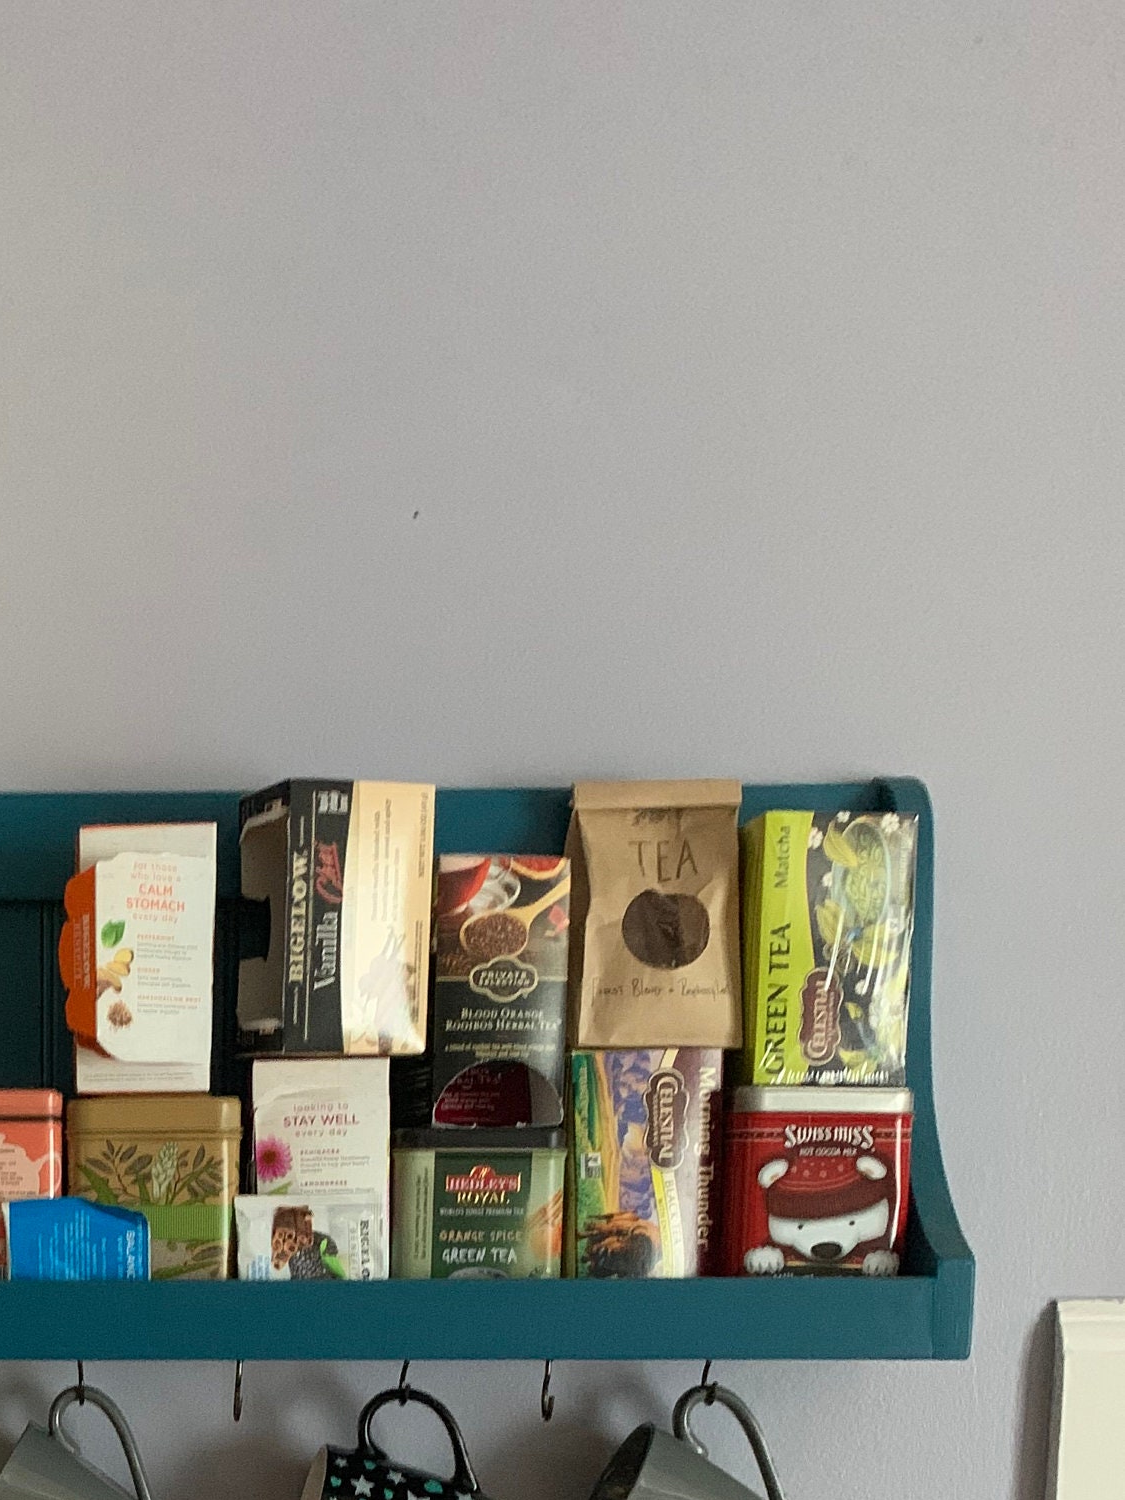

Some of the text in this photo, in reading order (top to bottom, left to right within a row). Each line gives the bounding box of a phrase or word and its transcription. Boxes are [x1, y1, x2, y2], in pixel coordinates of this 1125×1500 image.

[628, 839, 698, 883] TEA
[774, 825, 791, 888] Matcha
[153, 872, 173, 882] love
[314, 838, 343, 904] Chai
[138, 883, 173, 896] CALM
[126, 897, 185, 912] STOMACH
[132, 913, 179, 924] every day
[289, 850, 308, 983] BIGELOW
[313, 911, 338, 991] Vanilla
[762, 922, 791, 1075] GREEN TEA
[293, 1101, 349, 1112] looking to
[283, 1113, 360, 1128] STAY WELL
[657, 1075, 678, 1160] CELESTIAL
[295, 1127, 348, 1137] every day
[694, 1066, 717, 1249] Morning Thunder
[799, 1147, 858, 1156] HOT COCOA MIX
[457, 1191, 510, 1205] ROYAL
[439, 1230, 523, 1243] ORANGE SPICE
[126, 1230, 135, 1279] BALANC
[360, 1220, 370, 1279] BIGELO
[442, 1247, 517, 1264] GREEN TEA
